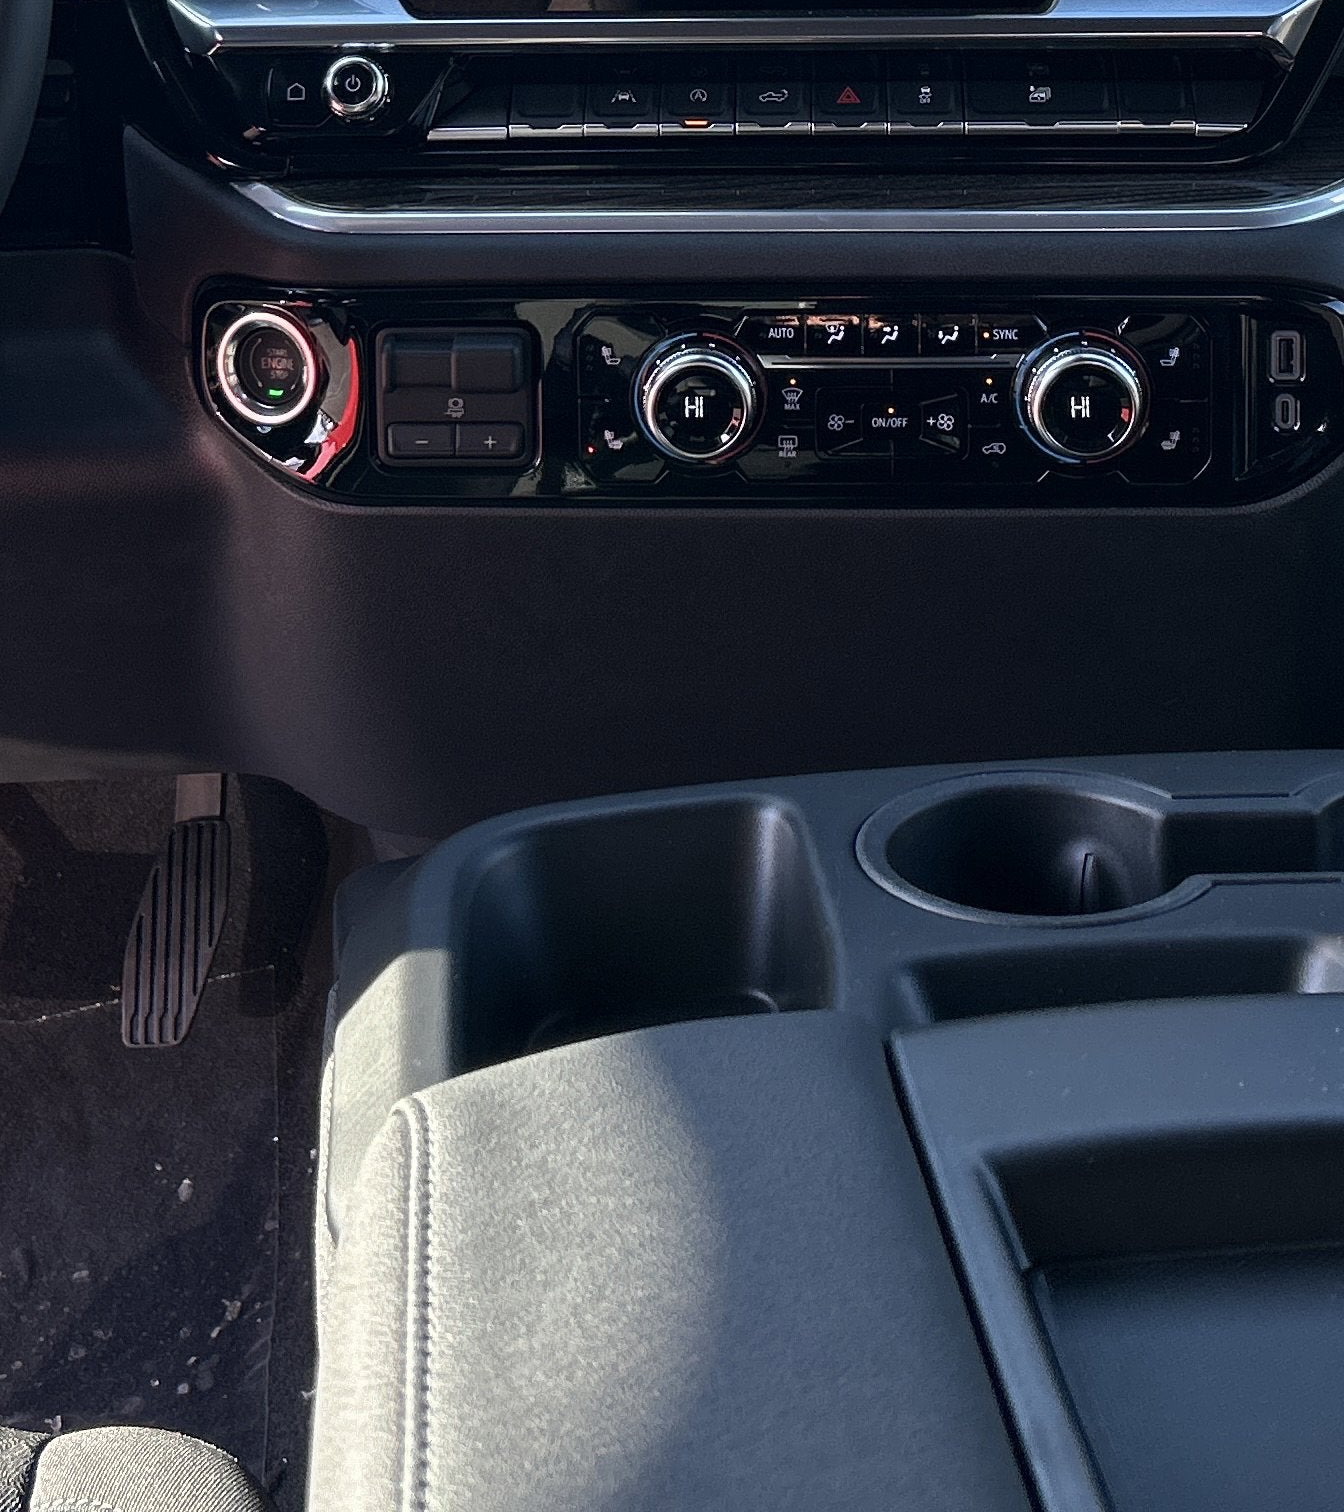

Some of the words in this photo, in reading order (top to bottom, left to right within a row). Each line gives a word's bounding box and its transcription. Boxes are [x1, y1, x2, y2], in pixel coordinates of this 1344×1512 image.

[768, 328, 794, 339] AUTO
[993, 330, 1019, 340] SYNC
[261, 358, 294, 370] ENGINE
[270, 370, 288, 379] STOP
[980, 393, 998, 404] A/C
[684, 396, 704, 418] HI
[784, 403, 800, 411] MAX
[1070, 397, 1091, 419] HI
[871, 417, 908, 428] ON/OFF
[778, 450, 797, 458] REAR
